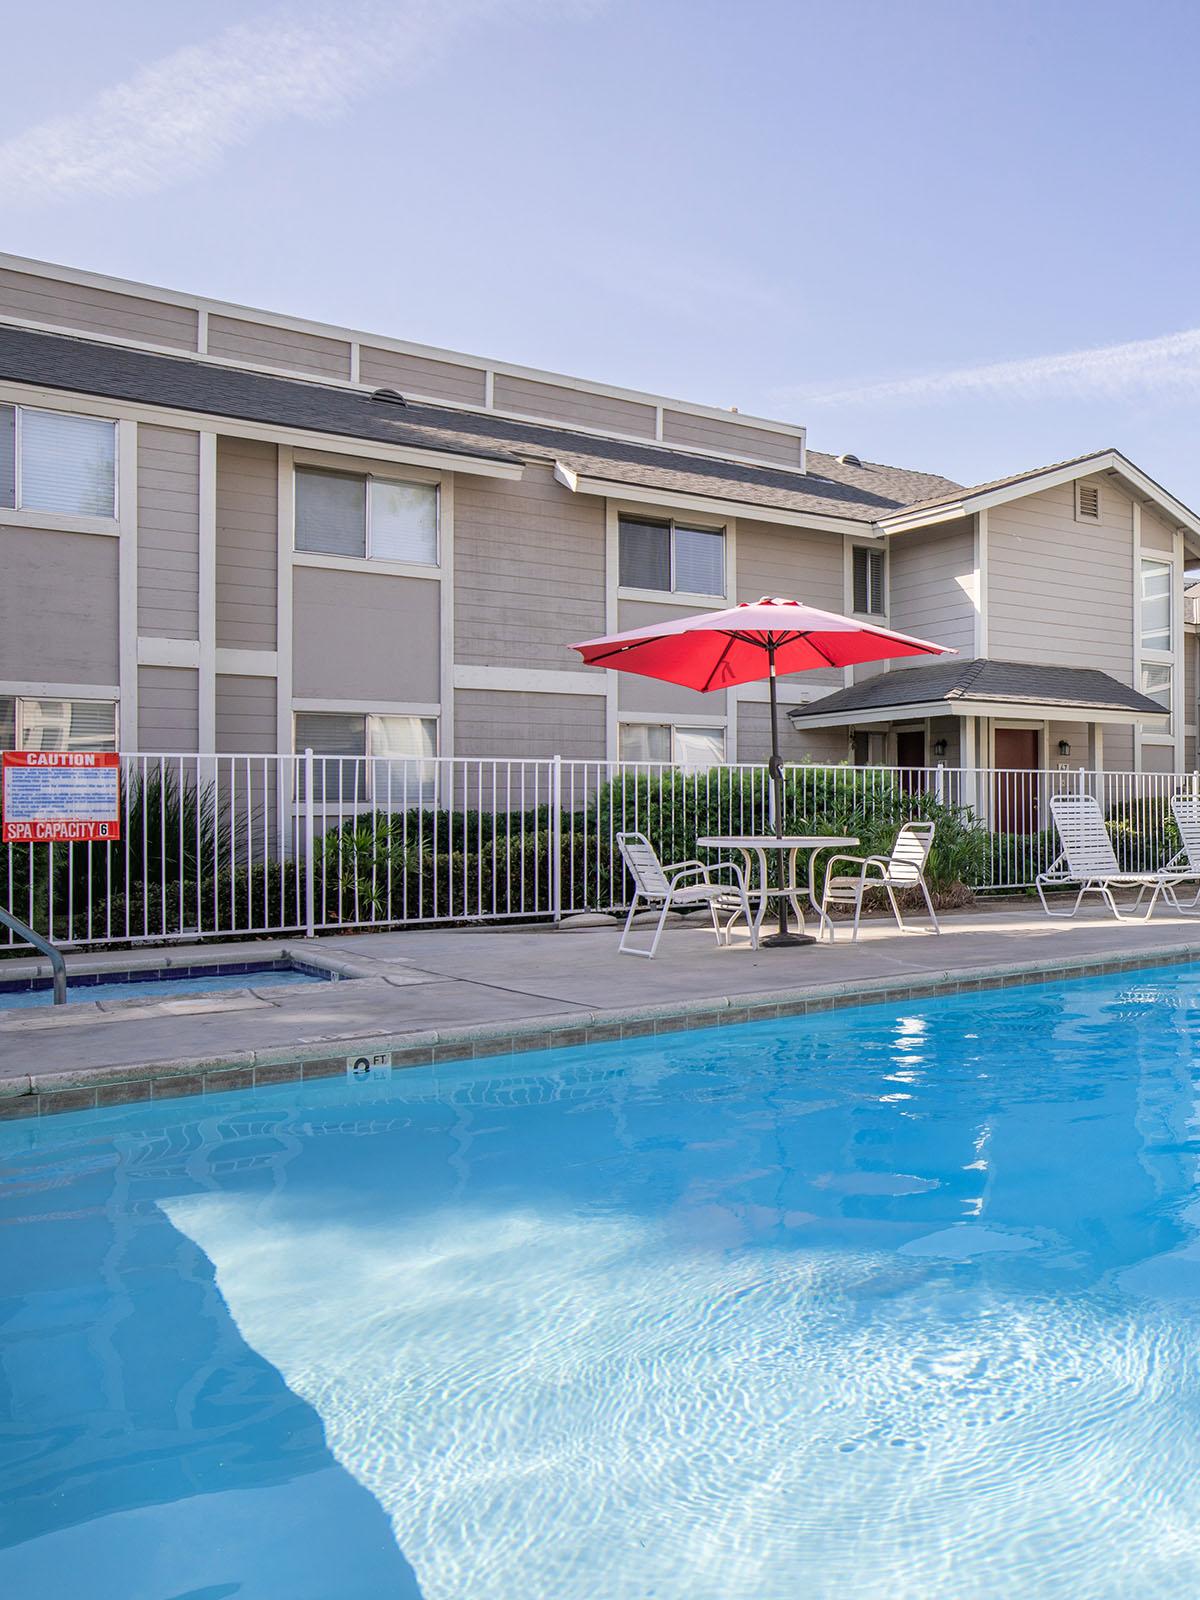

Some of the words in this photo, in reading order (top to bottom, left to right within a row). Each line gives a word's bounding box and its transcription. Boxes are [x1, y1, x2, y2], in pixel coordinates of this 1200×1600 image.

[26, 753, 95, 766] CAUTION
[7, 823, 32, 839] SPA
[36, 822, 95, 838] CAPACITY
[100, 824, 108, 835] 6
[373, 1055, 386, 1065] FT
